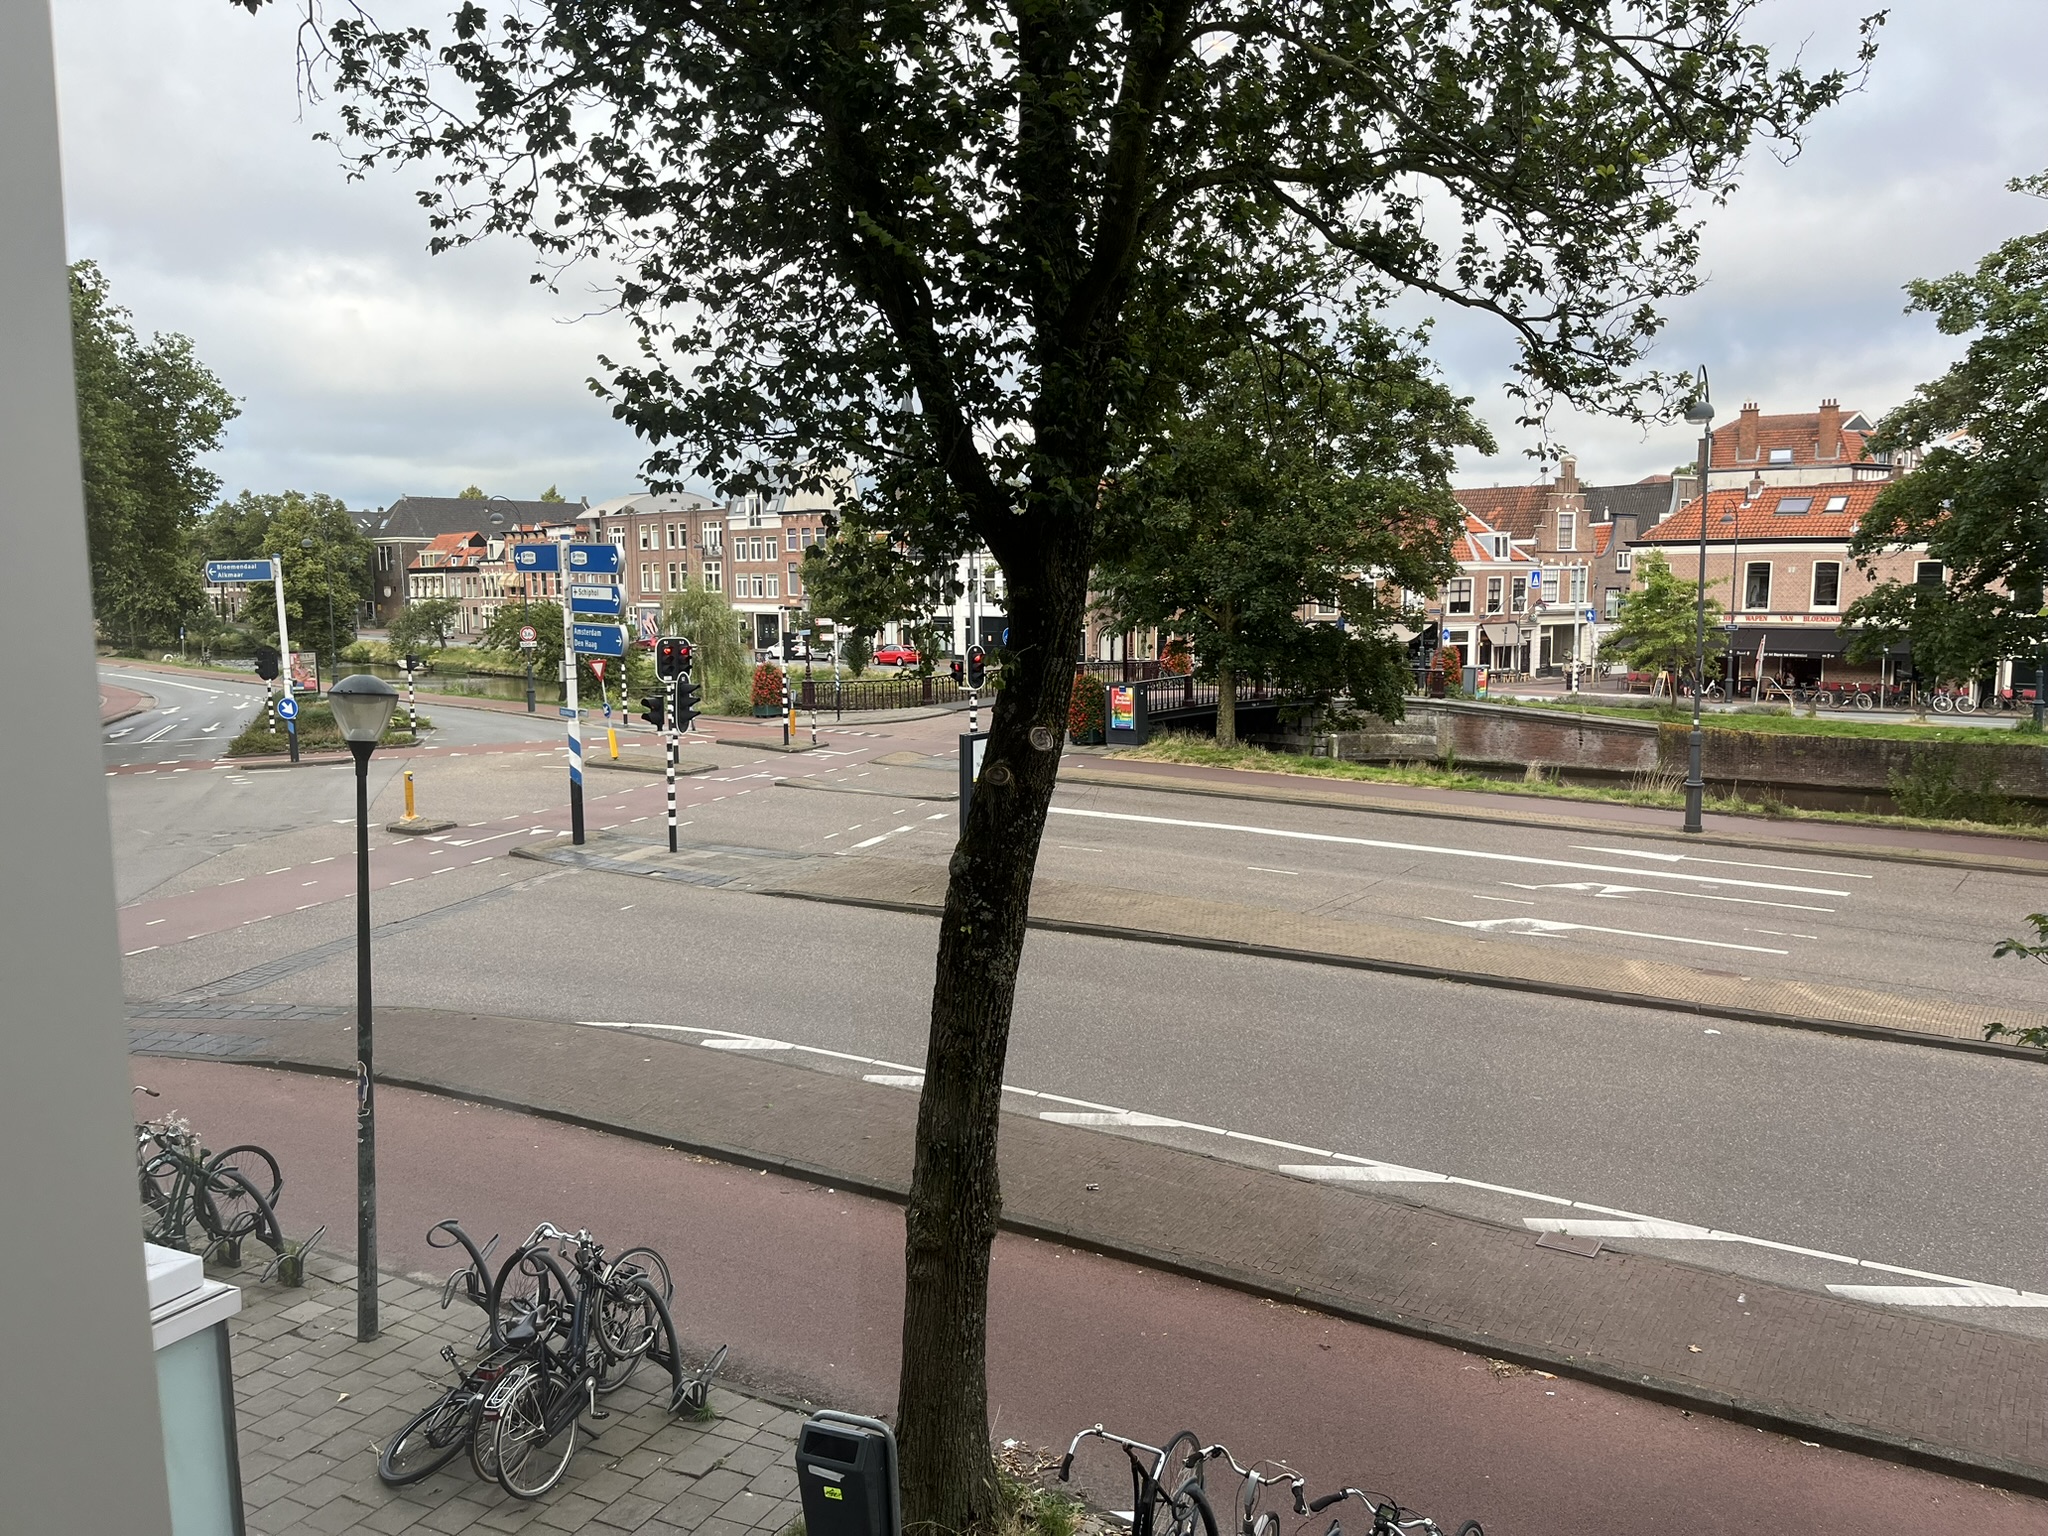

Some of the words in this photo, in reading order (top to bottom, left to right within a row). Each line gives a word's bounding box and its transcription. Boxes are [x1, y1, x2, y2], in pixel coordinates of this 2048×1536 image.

[578, 588, 599, 597] Schiphol
[574, 627, 602, 637] Amsterdam
[574, 639, 584, 647] Den
[584, 640, 598, 650] Haag
